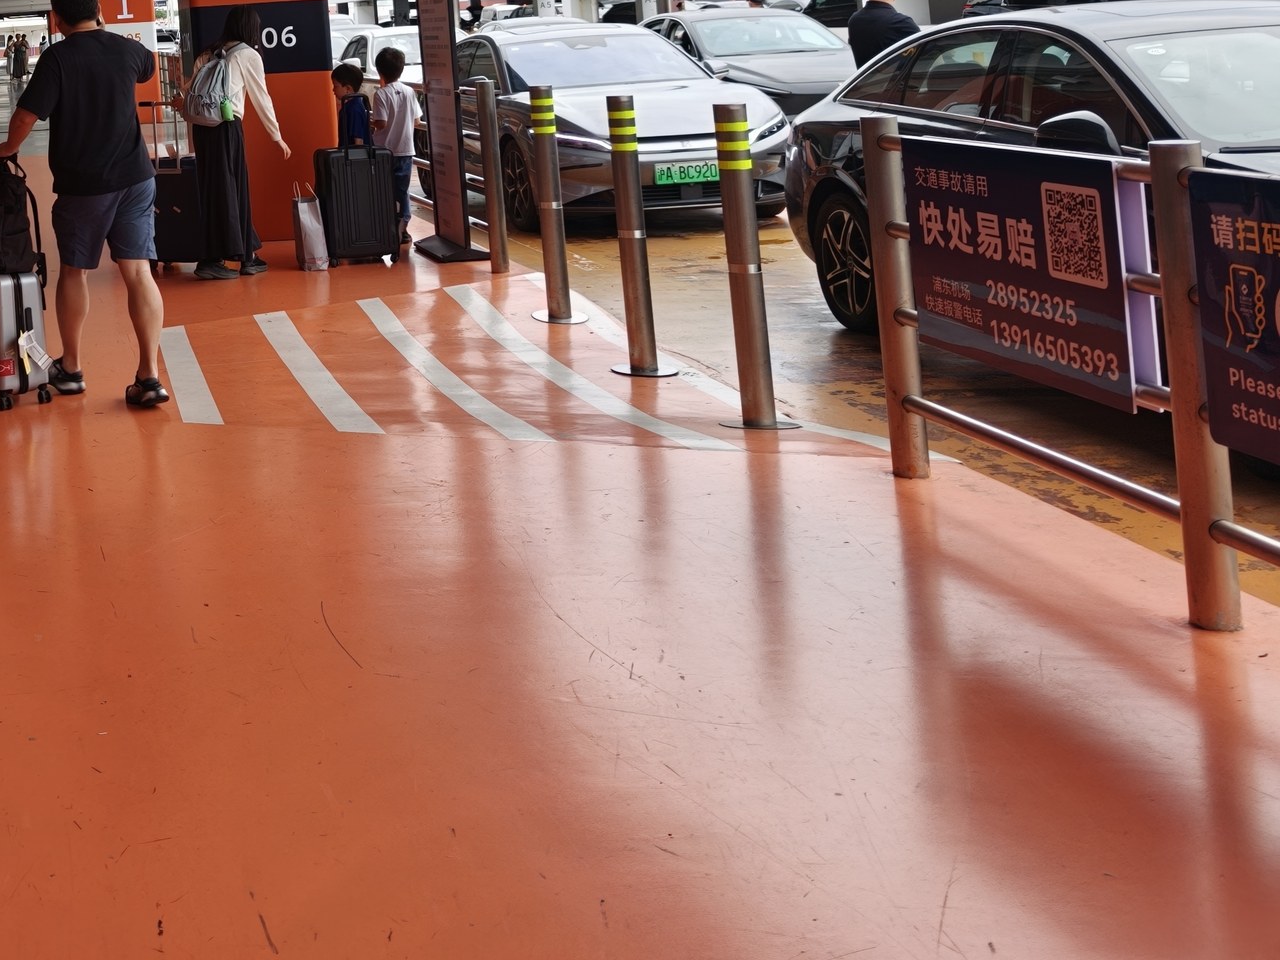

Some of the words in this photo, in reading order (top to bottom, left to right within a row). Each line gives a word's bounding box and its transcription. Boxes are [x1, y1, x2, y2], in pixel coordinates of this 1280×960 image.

[914, 166, 988, 198] 交通事故请用
[918, 199, 1037, 270] 快处易赔
[1210, 213, 1280, 258] 请扫码
[925, 293, 984, 328] 快速报警电话
[932, 275, 972, 302] 浦东机场
[985, 279, 1078, 327] 28952325
[990, 319, 1120, 382] 13916505393
